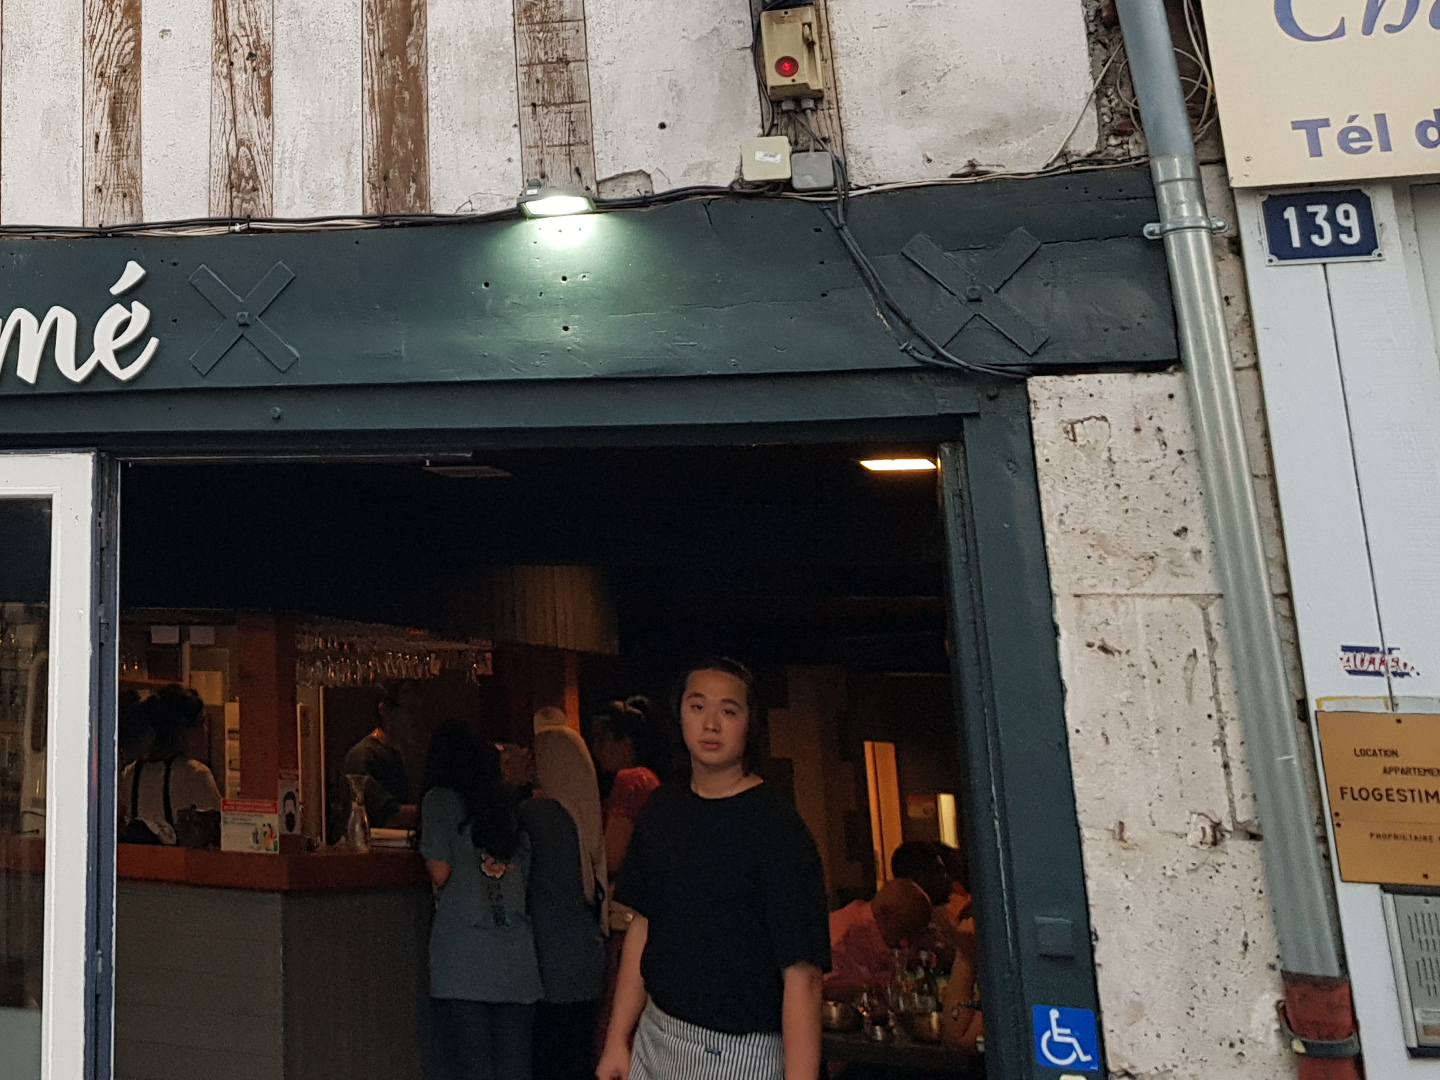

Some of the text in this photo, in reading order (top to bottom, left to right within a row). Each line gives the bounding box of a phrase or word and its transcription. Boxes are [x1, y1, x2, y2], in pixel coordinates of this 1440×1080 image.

[1291, 113, 1392, 158] Tél
[1283, 202, 1361, 249] 139
[1353, 747, 1400, 758] LOCATION
